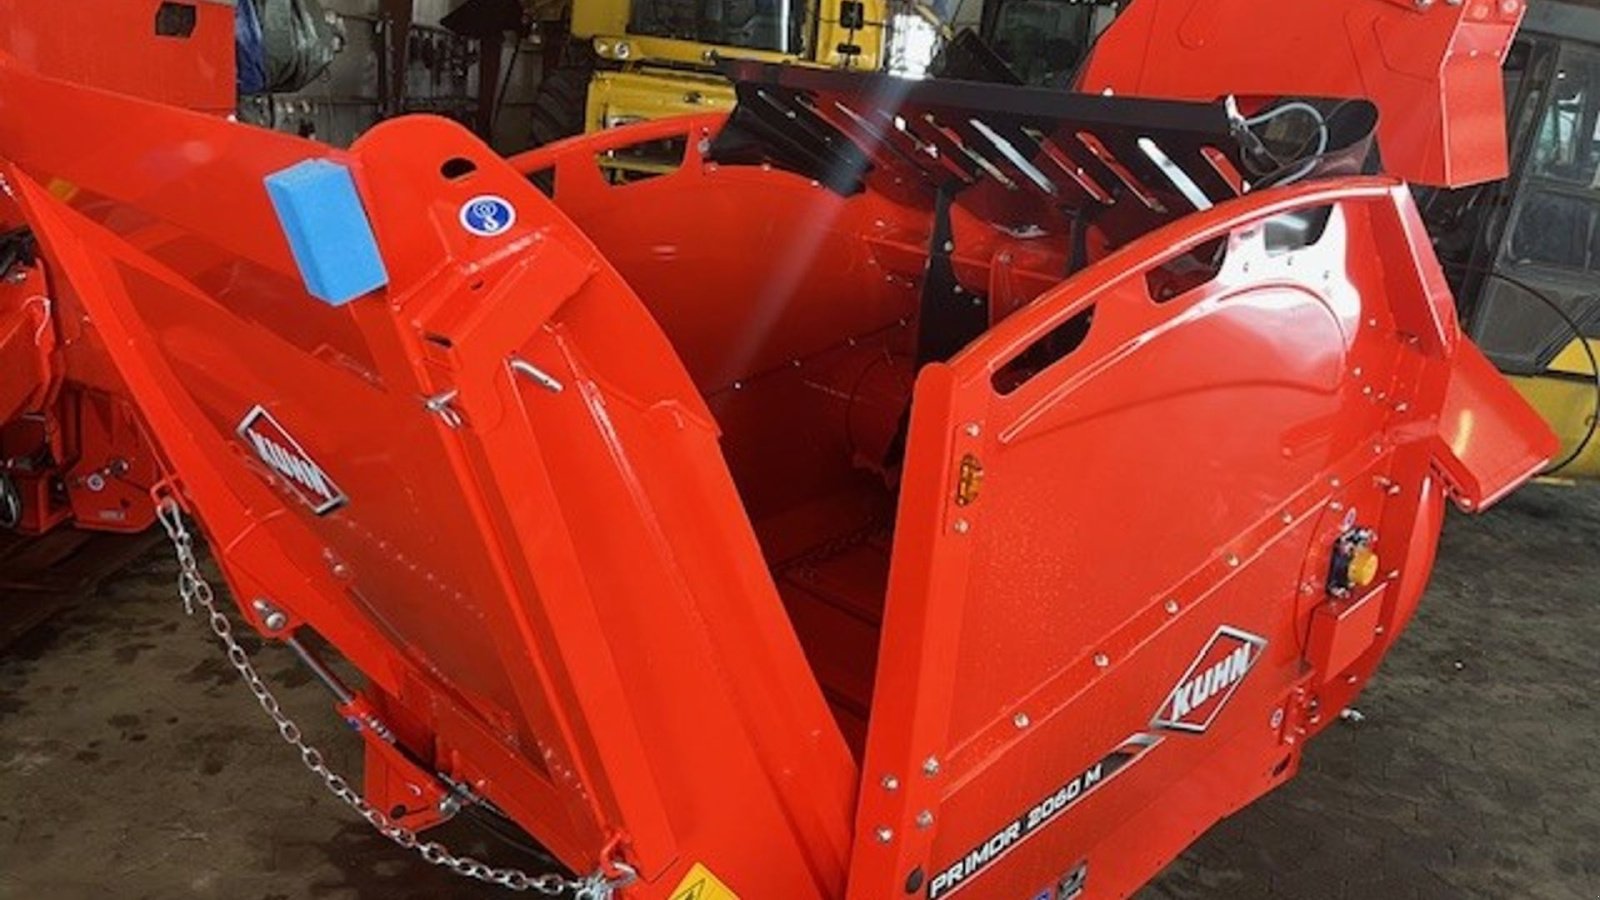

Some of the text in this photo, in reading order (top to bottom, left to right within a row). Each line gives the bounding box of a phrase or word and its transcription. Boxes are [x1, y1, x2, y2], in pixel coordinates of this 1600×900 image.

[246, 427, 333, 500] KUHN
[1171, 641, 1252, 722] KUHN
[930, 763, 1102, 898] PRIMOR 2060 M
